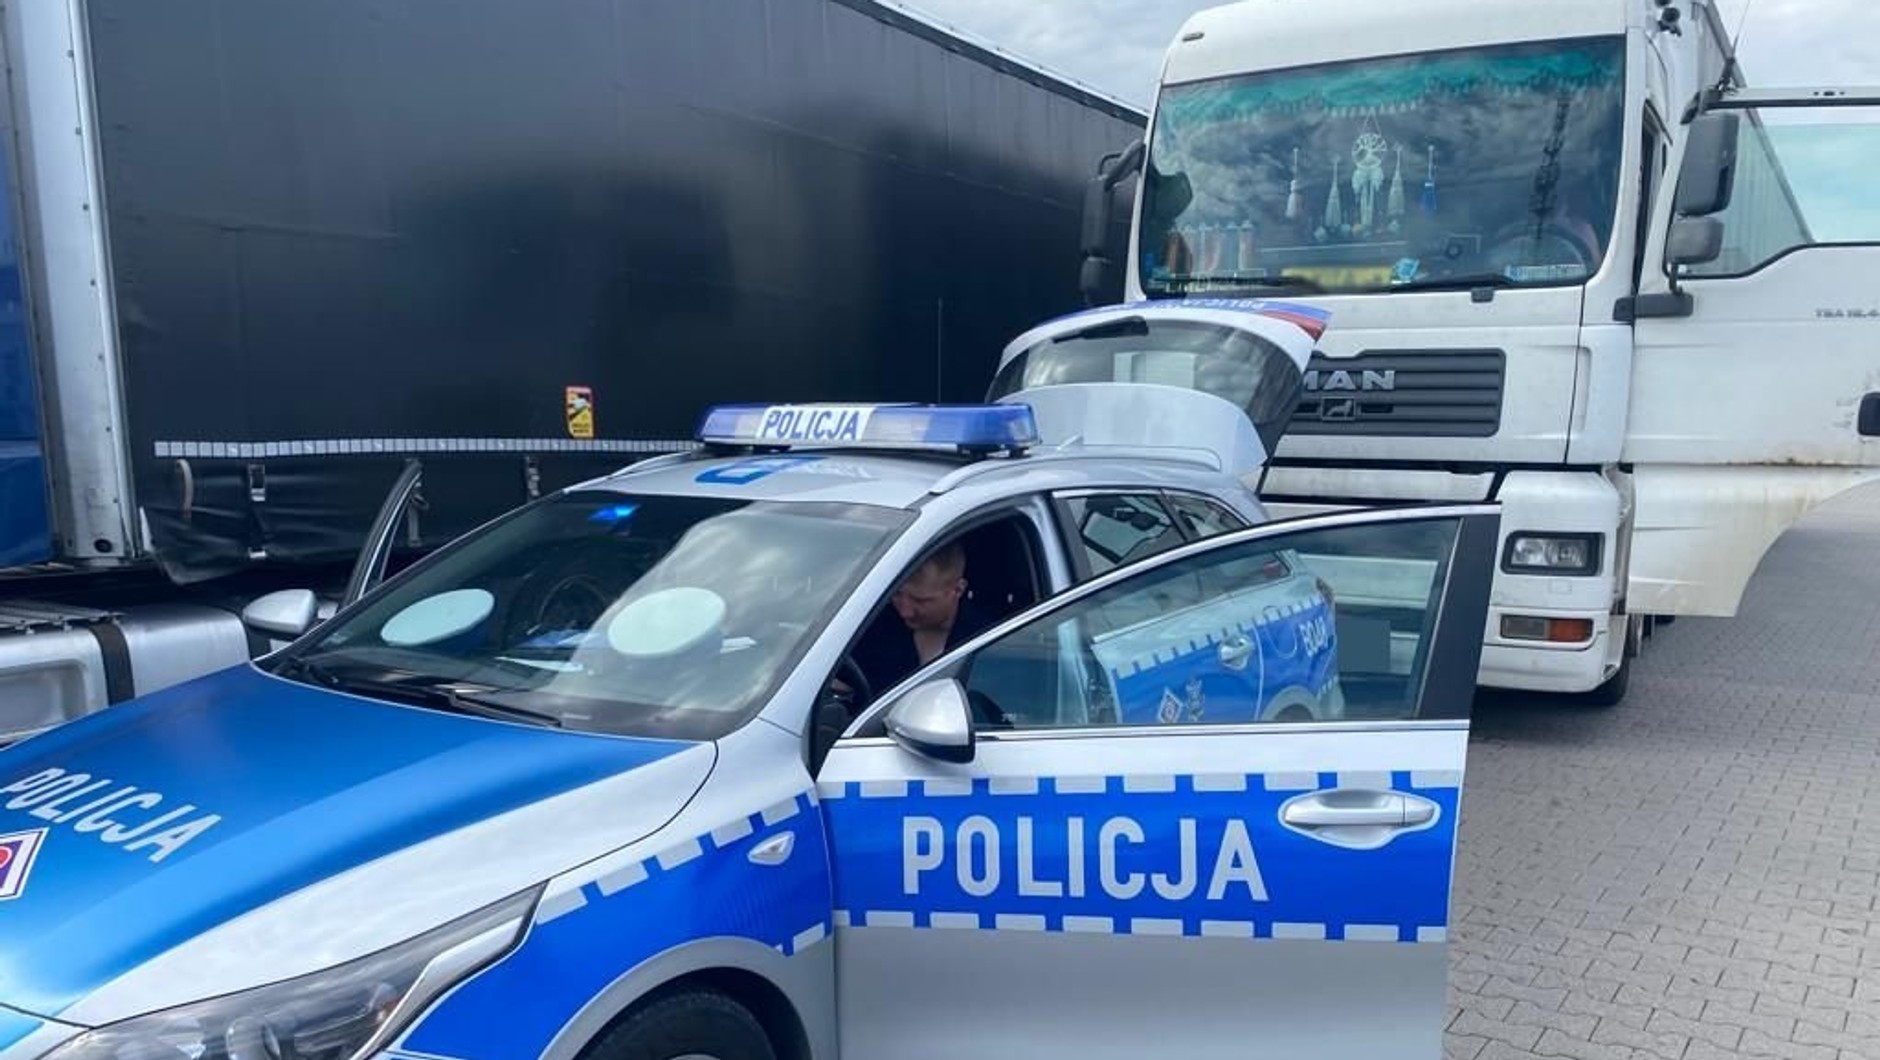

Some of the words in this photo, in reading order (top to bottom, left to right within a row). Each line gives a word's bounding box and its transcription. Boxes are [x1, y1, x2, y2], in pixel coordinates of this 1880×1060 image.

[761, 408, 859, 440] POLICJA
[0, 767, 222, 863] POLICJA
[903, 814, 1269, 901] POLICJA
